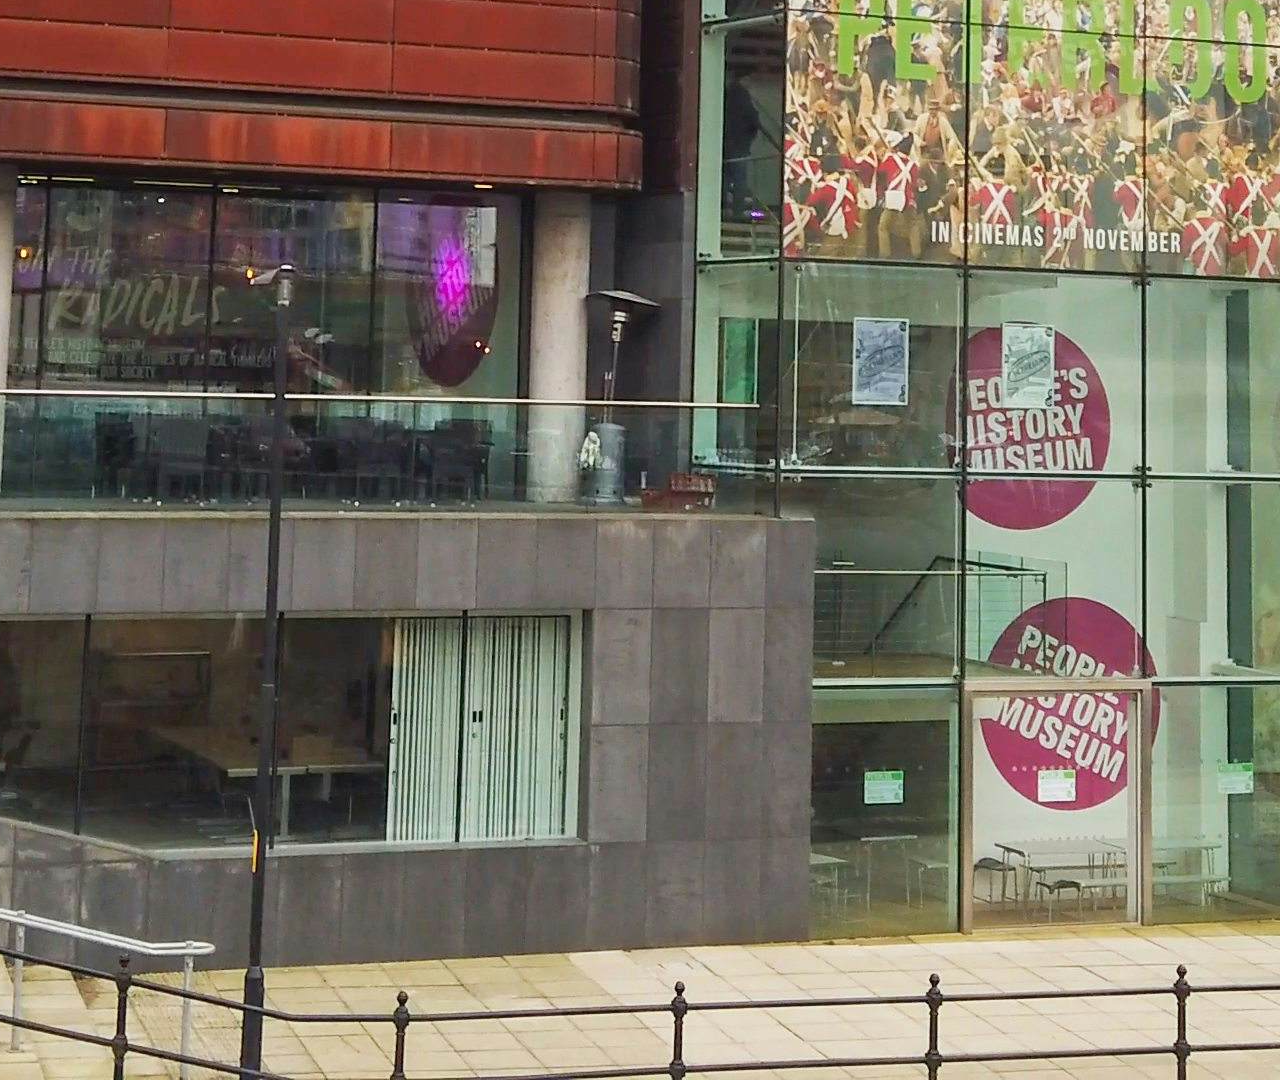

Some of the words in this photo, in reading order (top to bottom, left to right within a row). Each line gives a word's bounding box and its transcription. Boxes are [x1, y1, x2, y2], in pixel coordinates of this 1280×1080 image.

[931, 220, 950, 243] IN
[959, 221, 1044, 248] CINEMAS
[1083, 228, 1182, 254] NOVEMBER
[993, 697, 1126, 783] MUSEUM
